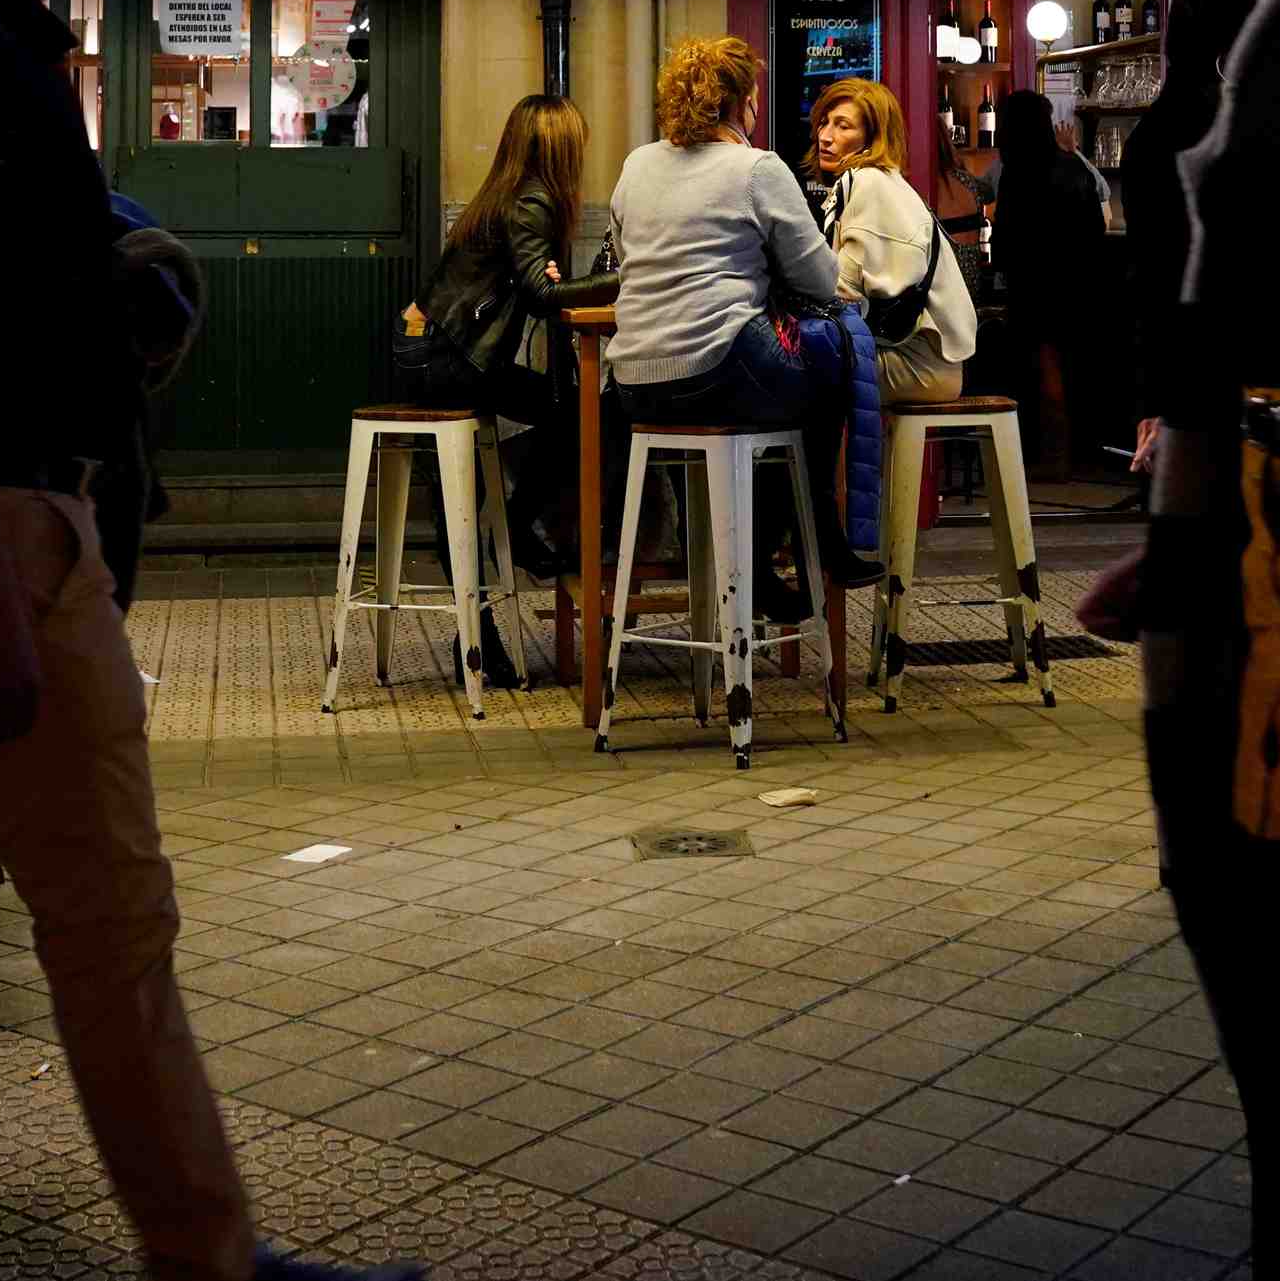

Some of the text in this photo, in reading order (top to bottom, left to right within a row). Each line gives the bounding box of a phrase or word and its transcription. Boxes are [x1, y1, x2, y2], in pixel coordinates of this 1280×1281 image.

[211, 3, 232, 11] LOCAL
[219, 24, 232, 33] LAS
[168, 35, 193, 43] MESAS
[806, 46, 843, 57] CERVEZA
